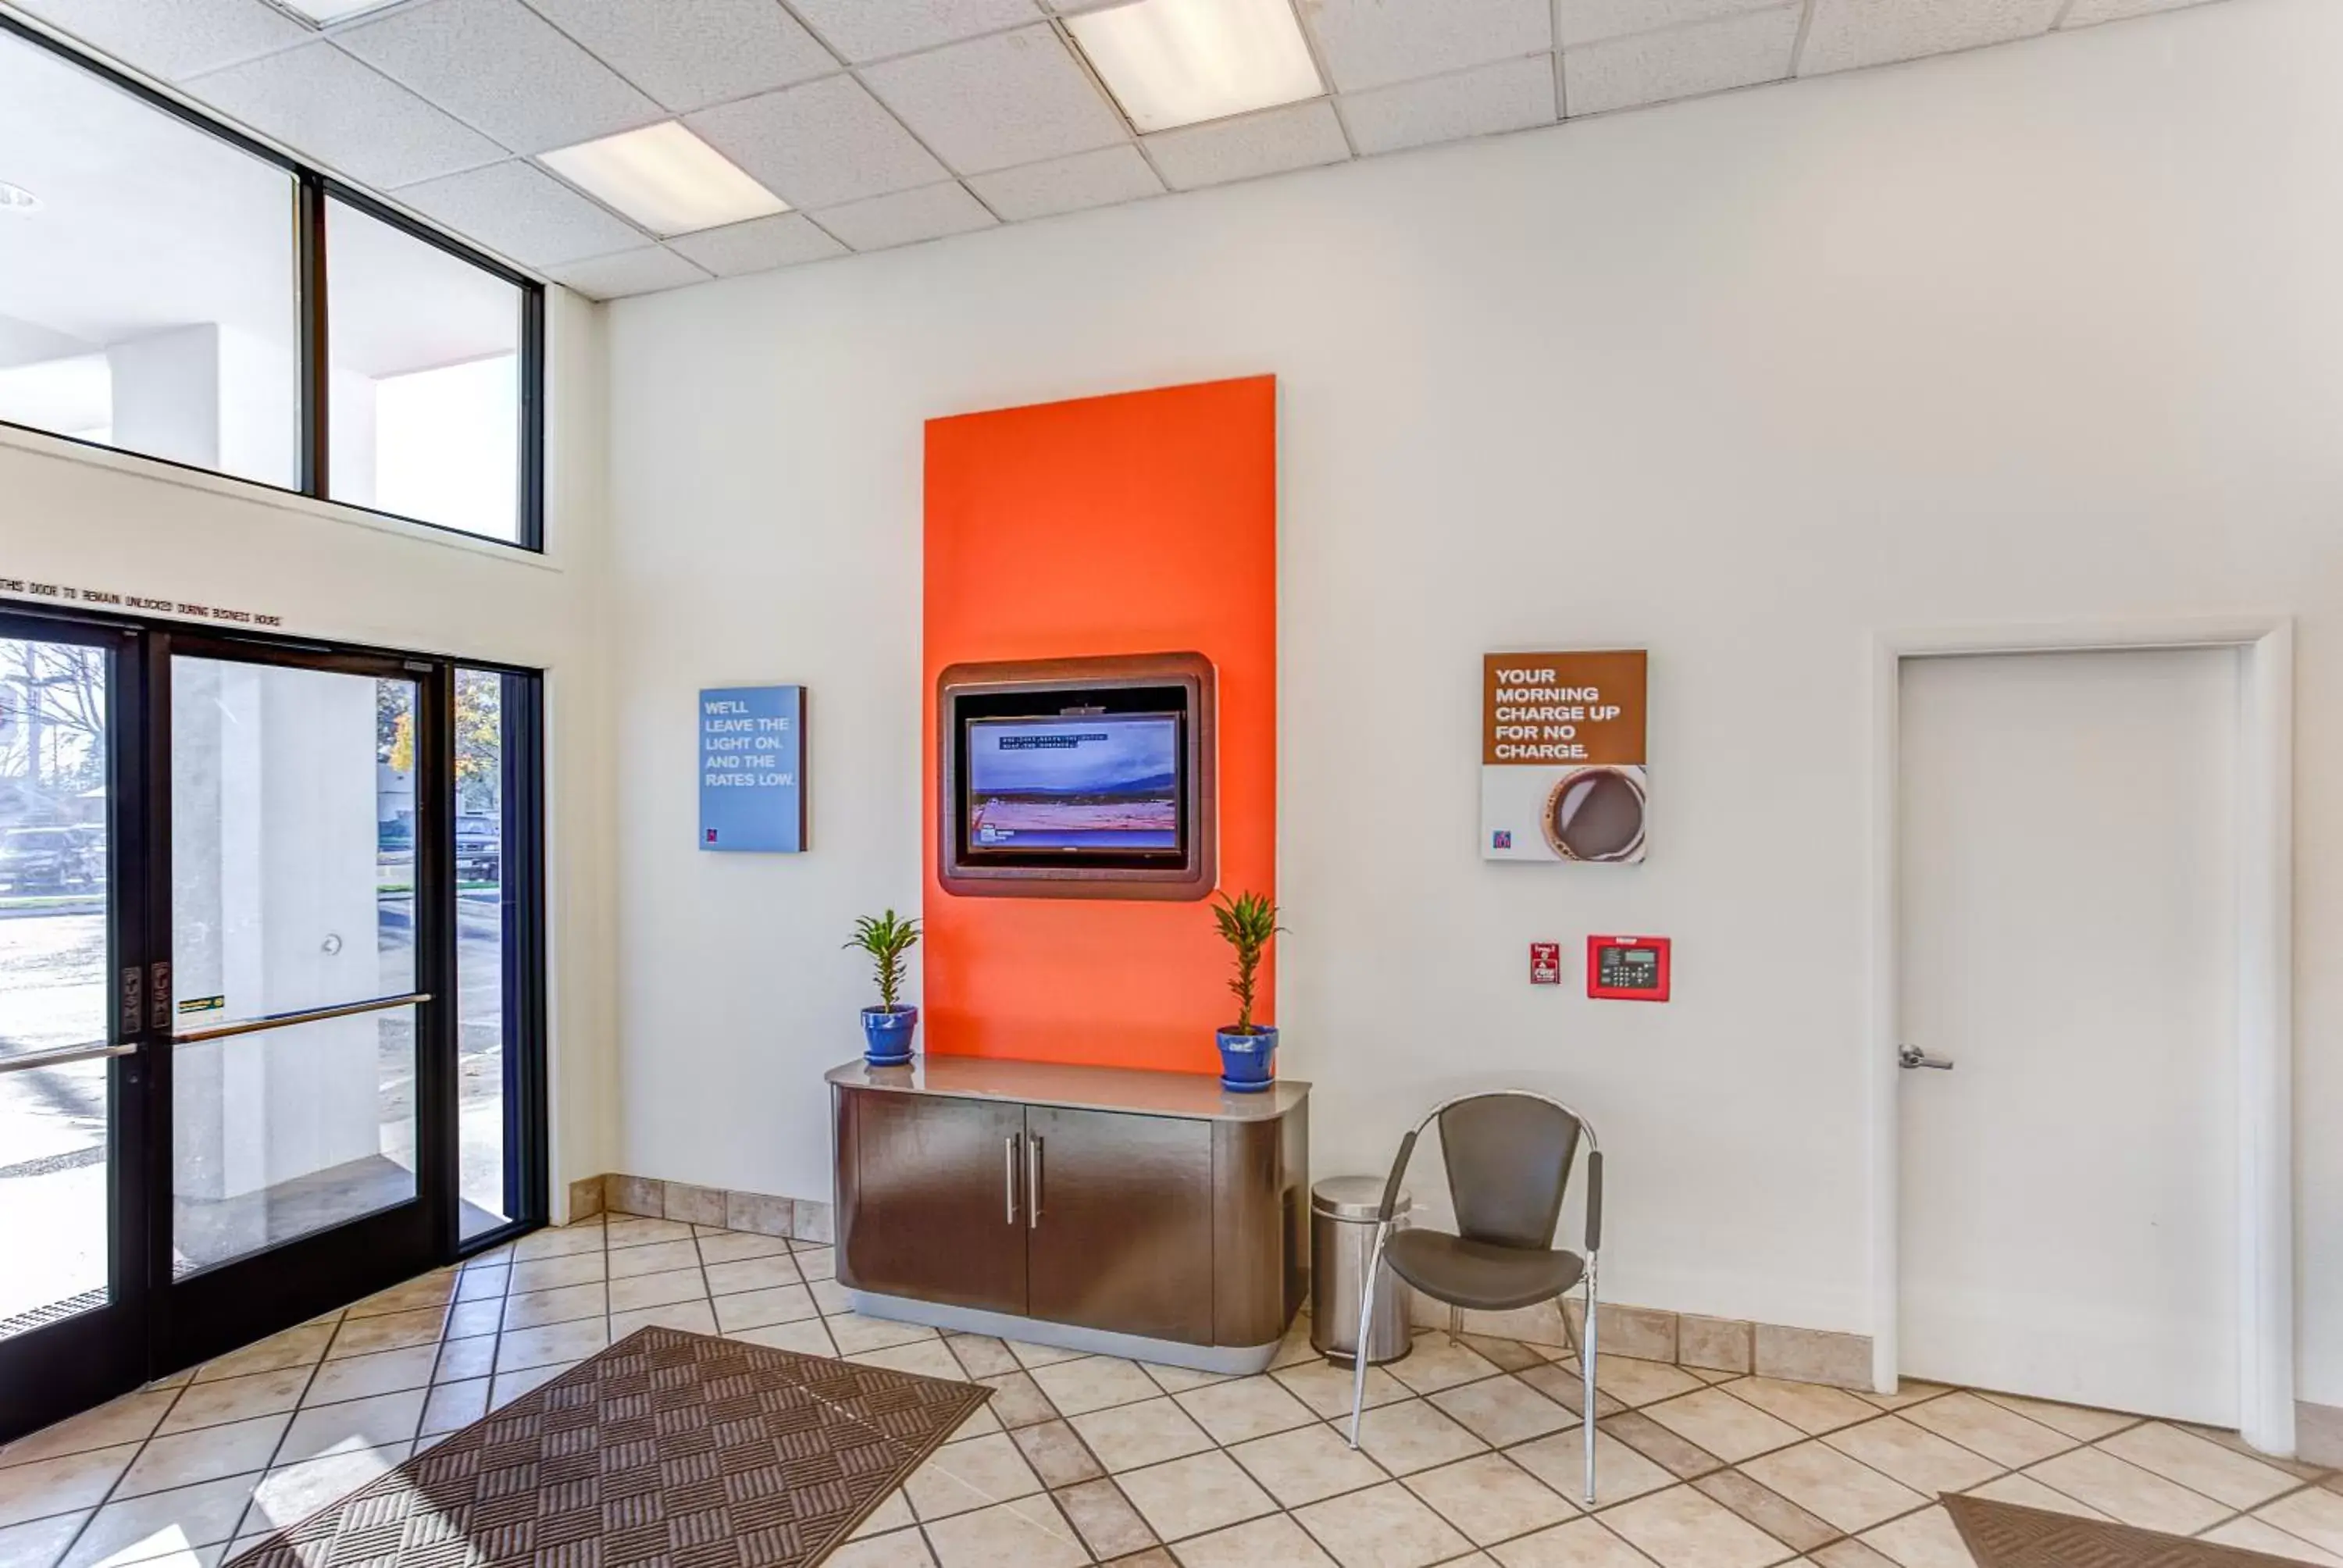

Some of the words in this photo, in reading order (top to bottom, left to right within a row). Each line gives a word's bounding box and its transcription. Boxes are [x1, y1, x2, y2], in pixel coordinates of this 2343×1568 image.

[30, 582, 58, 596] DOOR
[64, 587, 76, 599] TO
[84, 590, 119, 604] REMAIN
[126, 596, 172, 611] UNLOCKED
[177, 604, 209, 617] DURING
[212, 608, 250, 622] BUSINESS
[254, 614, 282, 625] HOURS
[1496, 669, 1556, 683] YOUR
[1496, 687, 1599, 701] MORNING
[705, 701, 748, 714] WE'LL
[1496, 707, 1585, 721] CHARGE
[1589, 706, 1621, 720] UP
[706, 719, 753, 732] LEAVE
[758, 718, 789, 731] THE
[1496, 725, 1538, 739] FOR
[1543, 725, 1575, 739] NO
[706, 737, 751, 750] LIGHT
[755, 736, 783, 749] ON.
[1496, 744, 1589, 758] CHARGE.
[707, 755, 740, 768] AND
[744, 755, 775, 768] THE
[706, 773, 754, 786] RATES
[759, 772, 794, 786] LOW.
